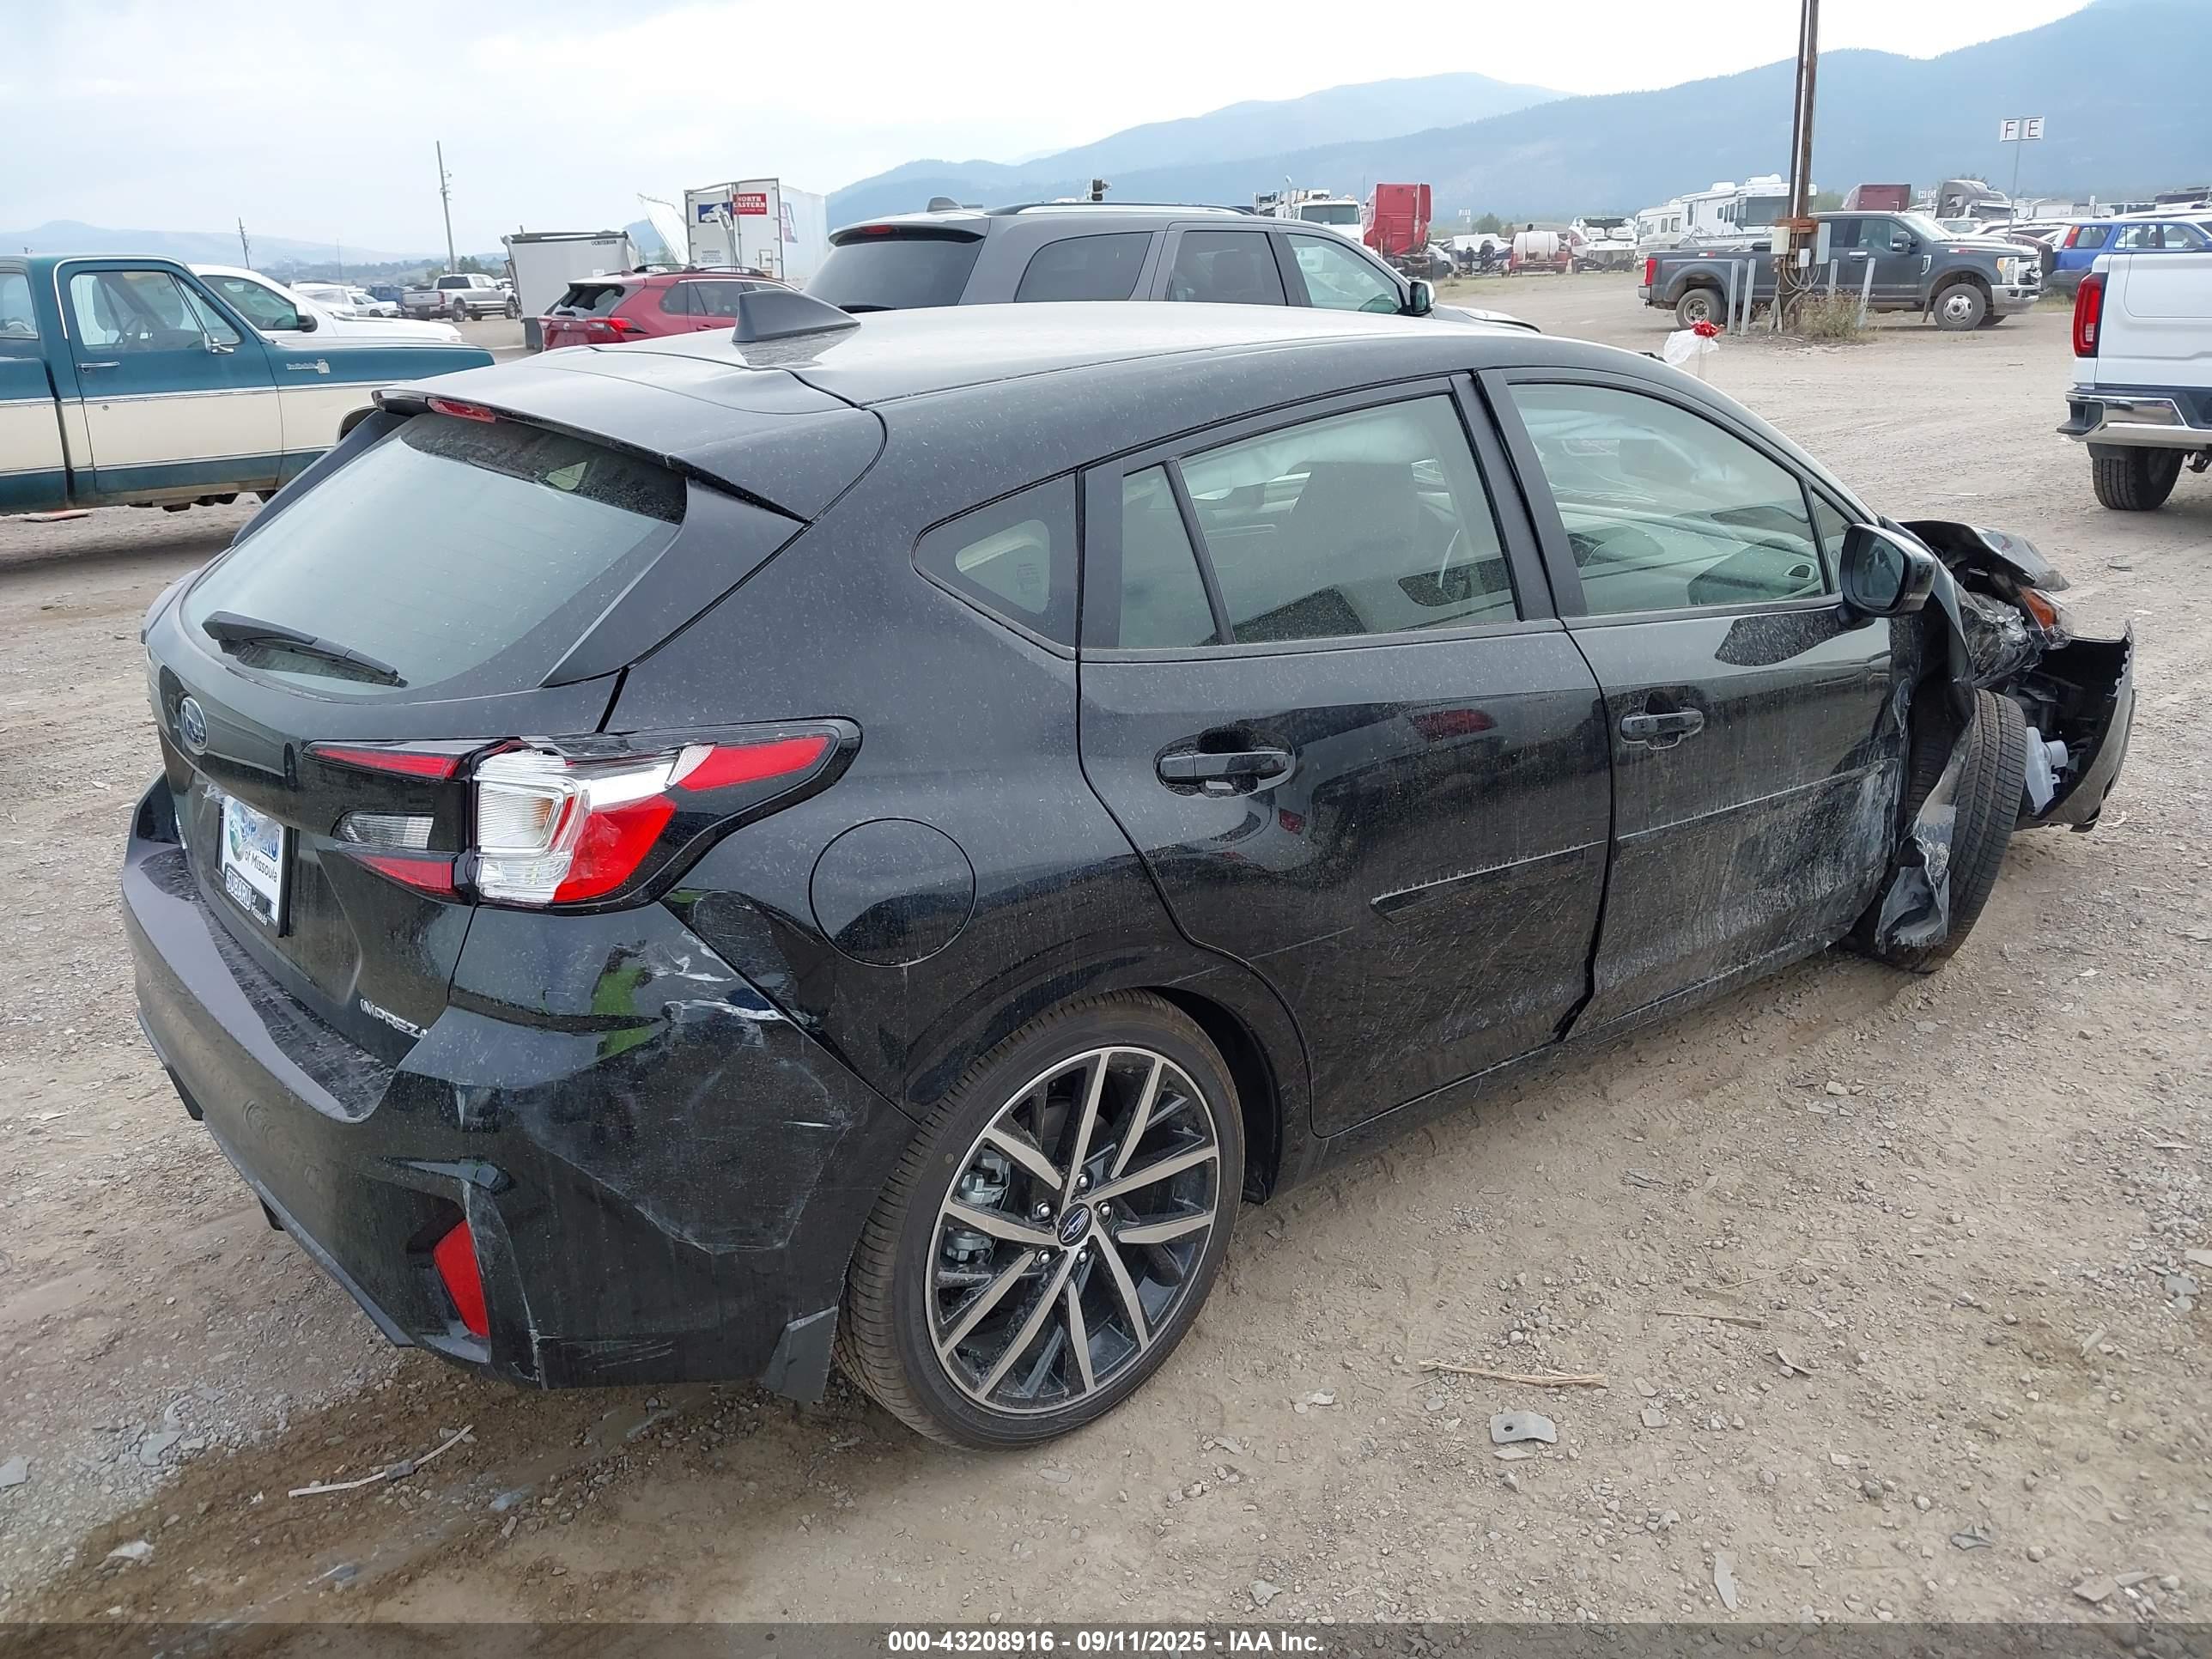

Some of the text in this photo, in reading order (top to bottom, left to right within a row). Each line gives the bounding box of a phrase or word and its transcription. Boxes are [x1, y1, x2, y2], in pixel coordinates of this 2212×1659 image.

[2005, 120, 2039, 138] F E
[251, 853, 277, 883] Missoula
[226, 869, 252, 908] SUBARU
[360, 999, 428, 1038] IMPREZA
